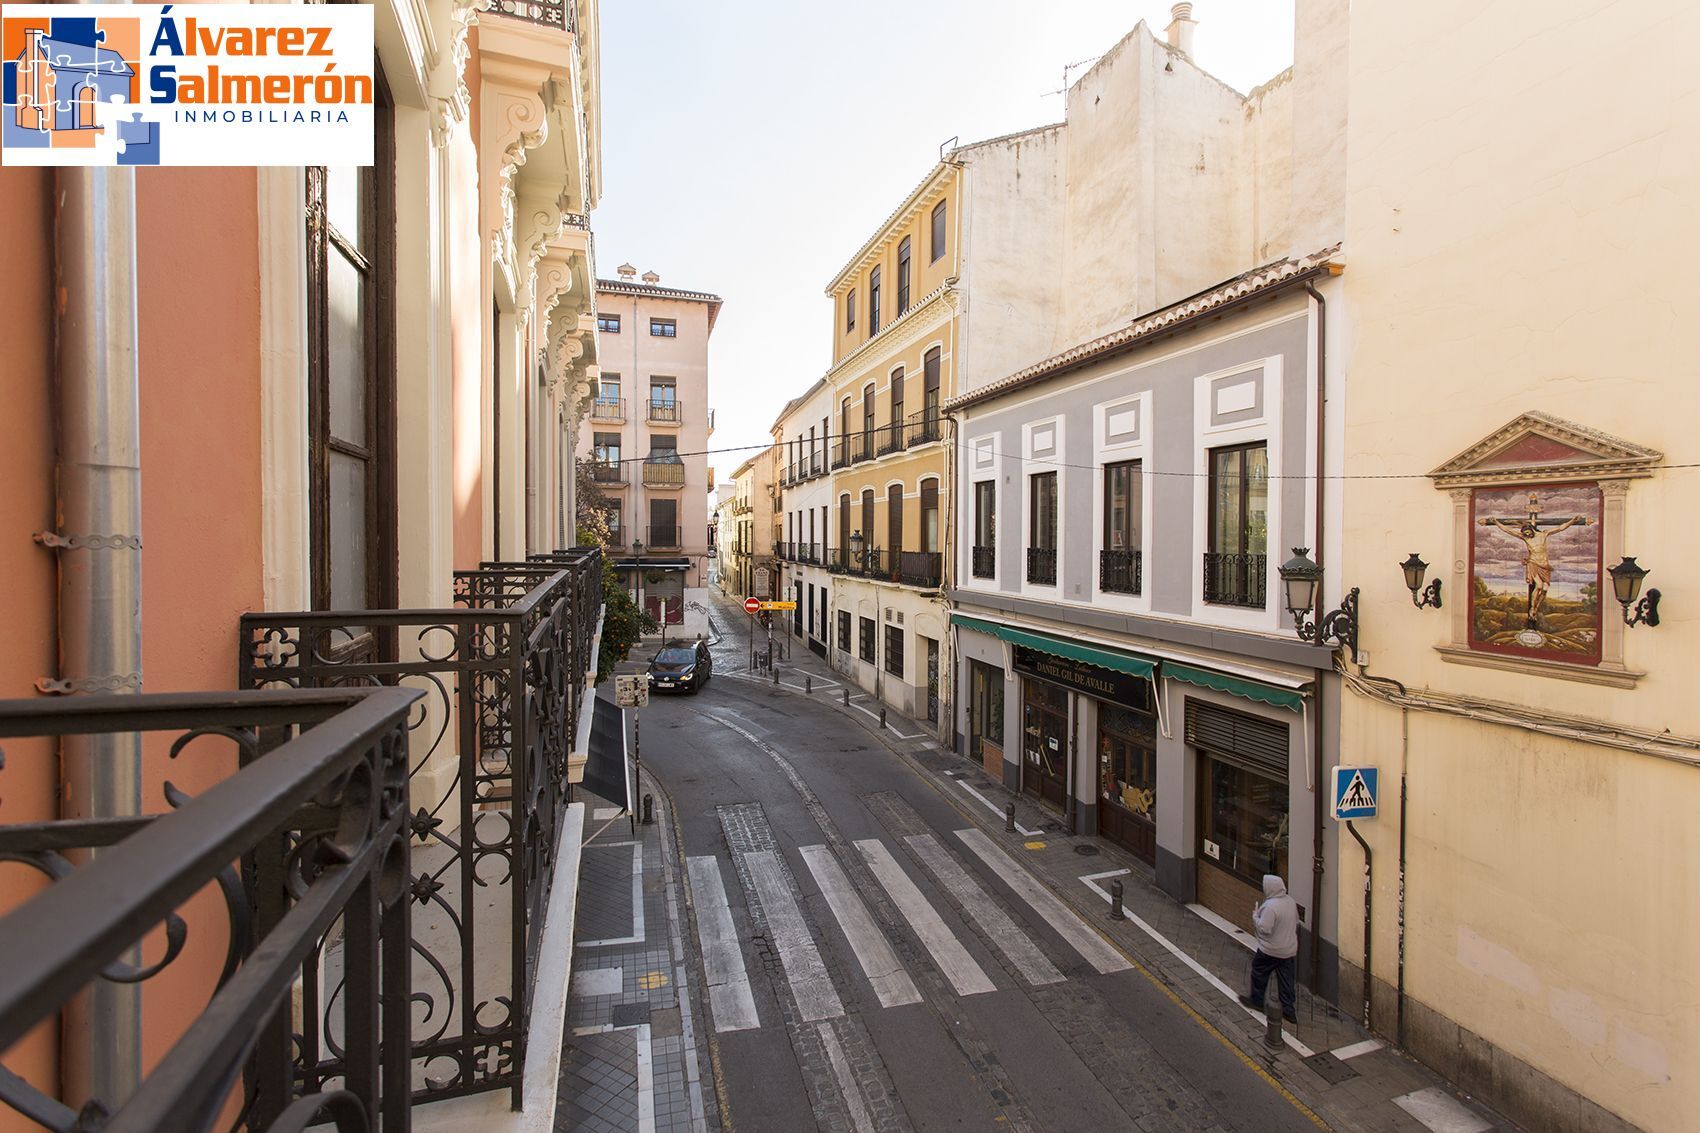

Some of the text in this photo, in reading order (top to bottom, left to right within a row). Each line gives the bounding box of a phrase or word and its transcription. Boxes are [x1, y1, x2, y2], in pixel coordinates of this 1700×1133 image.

[1036, 662, 1061, 677] DANIEL
[1061, 669, 1074, 681] GIL
[1074, 673, 1085, 685] DE
[1085, 677, 1114, 693] AVALLE
